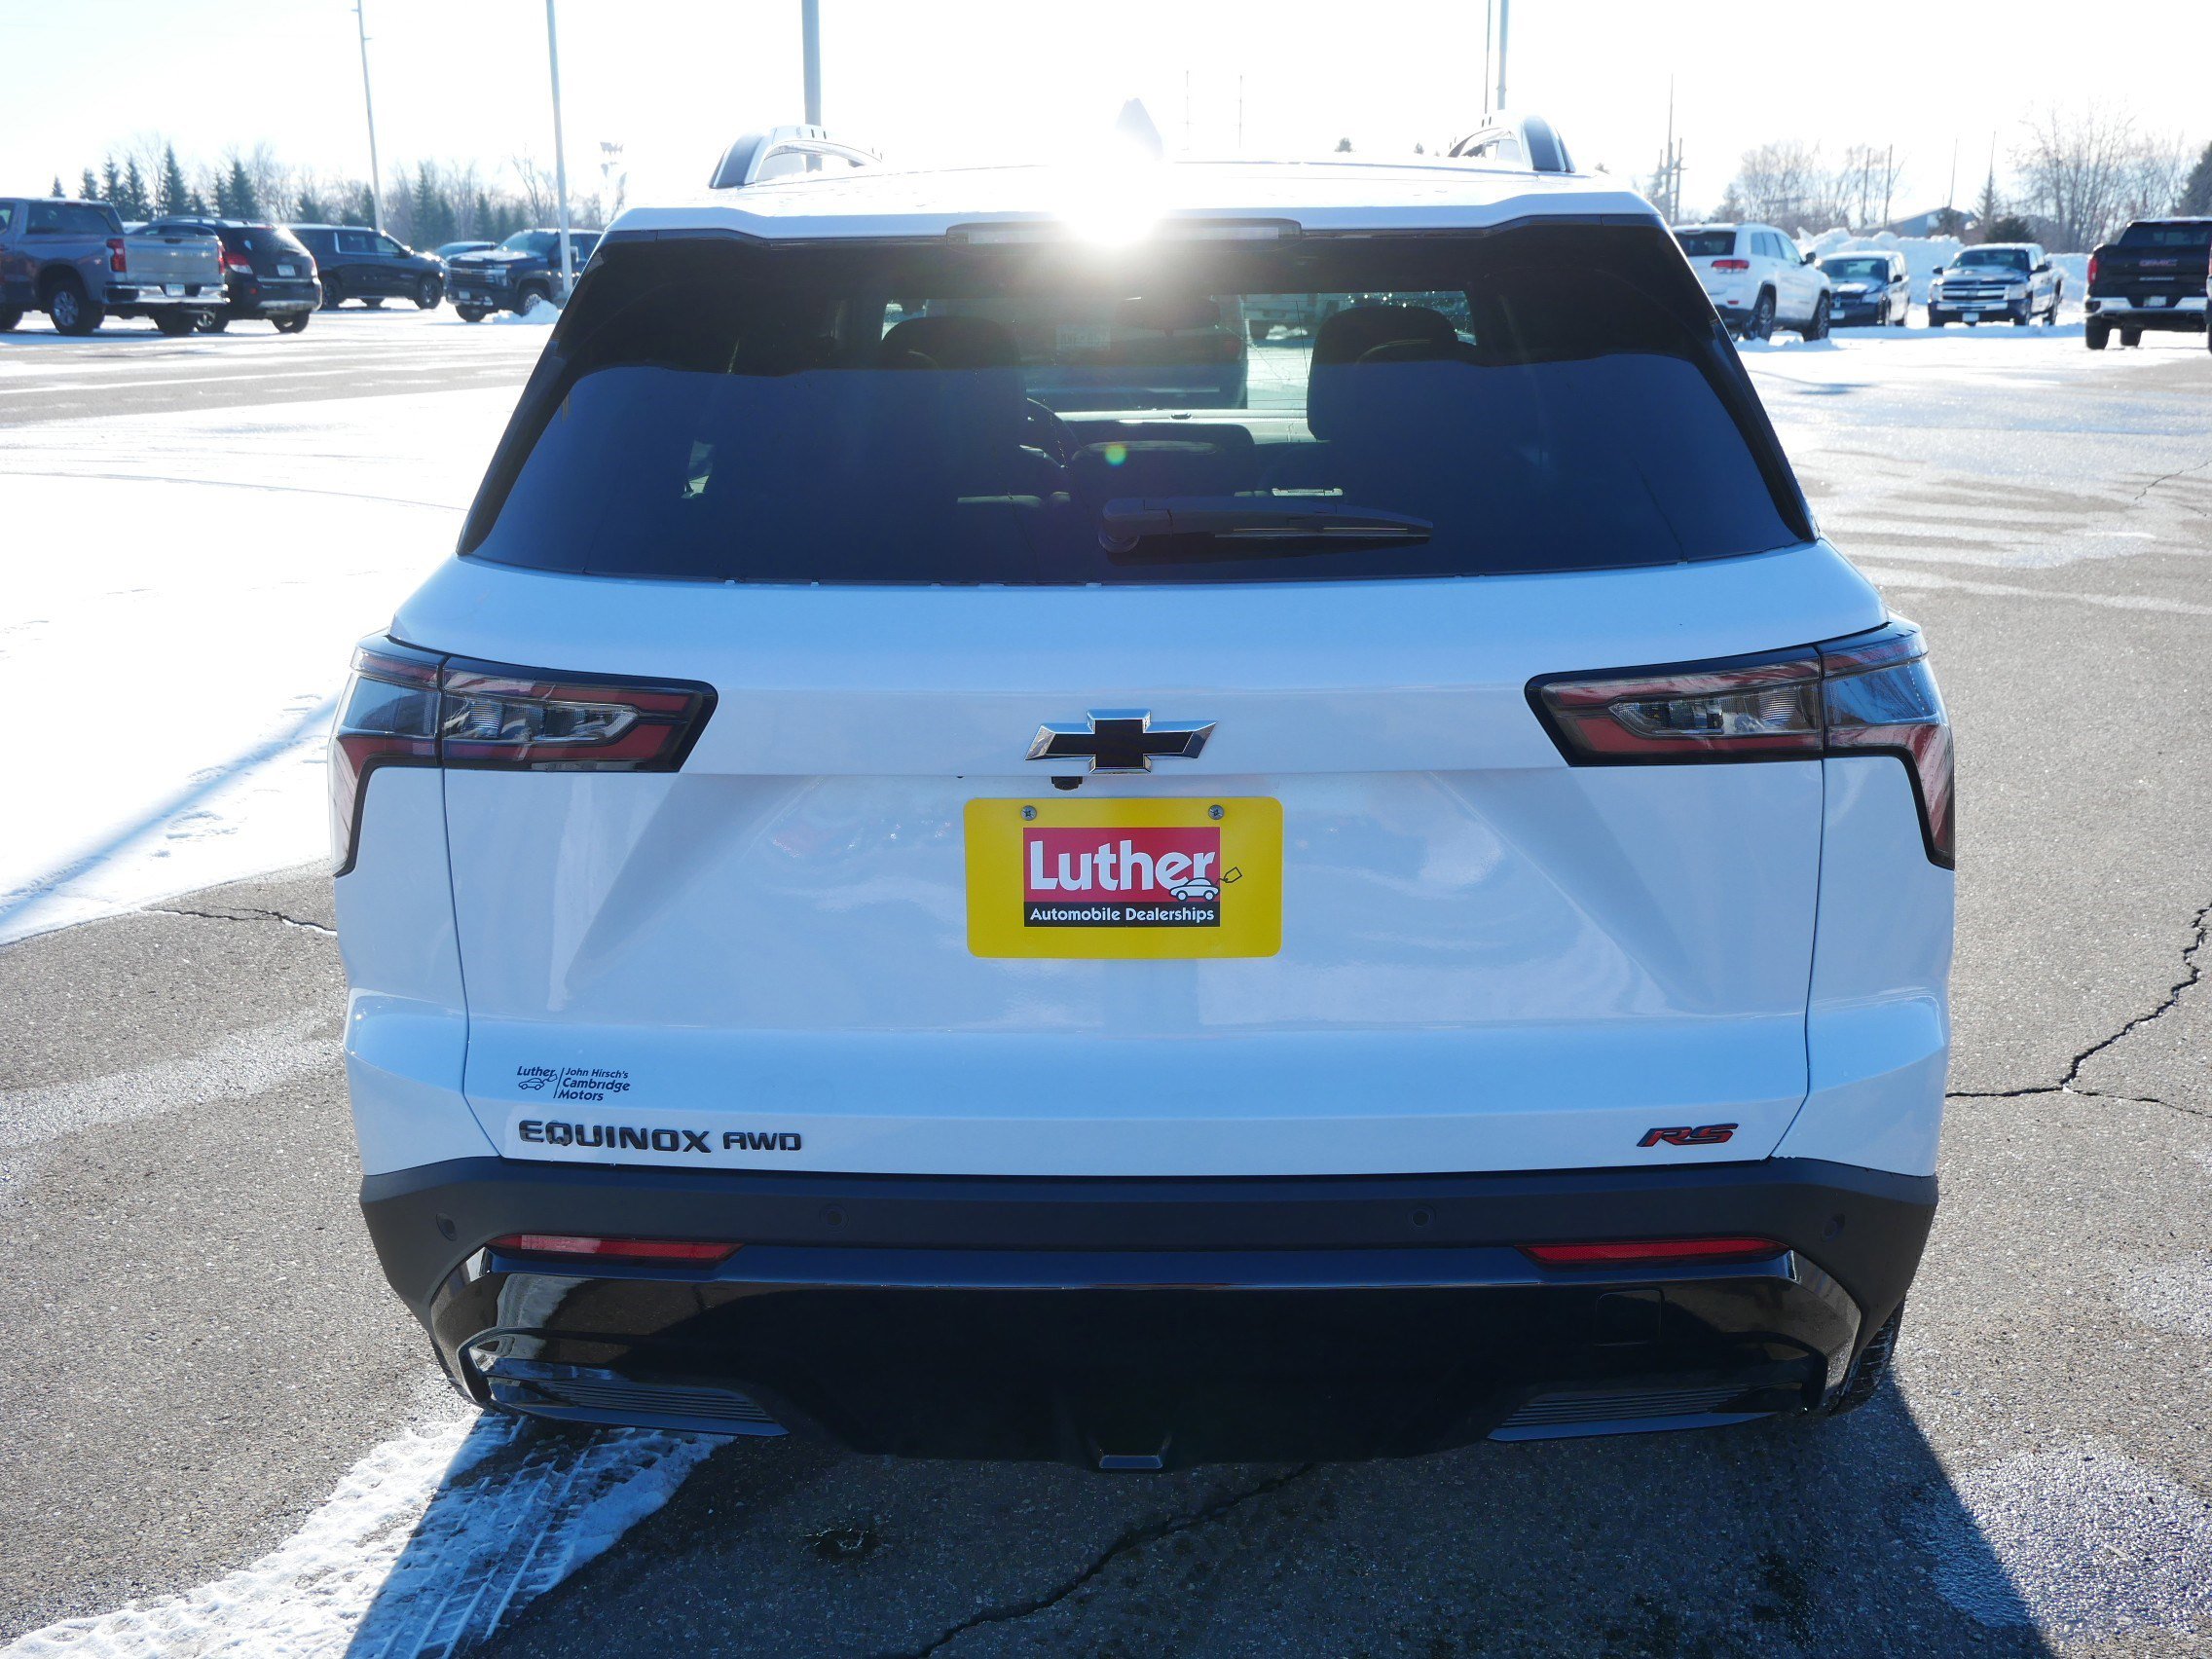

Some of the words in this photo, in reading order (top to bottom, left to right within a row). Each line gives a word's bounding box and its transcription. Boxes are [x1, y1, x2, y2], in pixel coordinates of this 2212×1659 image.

[1030, 839, 1216, 892] Luther
[1029, 906, 1121, 922] Automobile
[1125, 906, 1215, 924] Dealerships
[516, 1065, 556, 1078] Luther
[565, 1067, 589, 1077] John
[591, 1068, 629, 1080] Hirsch's
[562, 1077, 631, 1093] Cambridge
[557, 1089, 605, 1102] Motors
[518, 1119, 712, 1154] EQUINOX
[722, 1131, 802, 1152] AWD
[1636, 1123, 1740, 1148] RS
